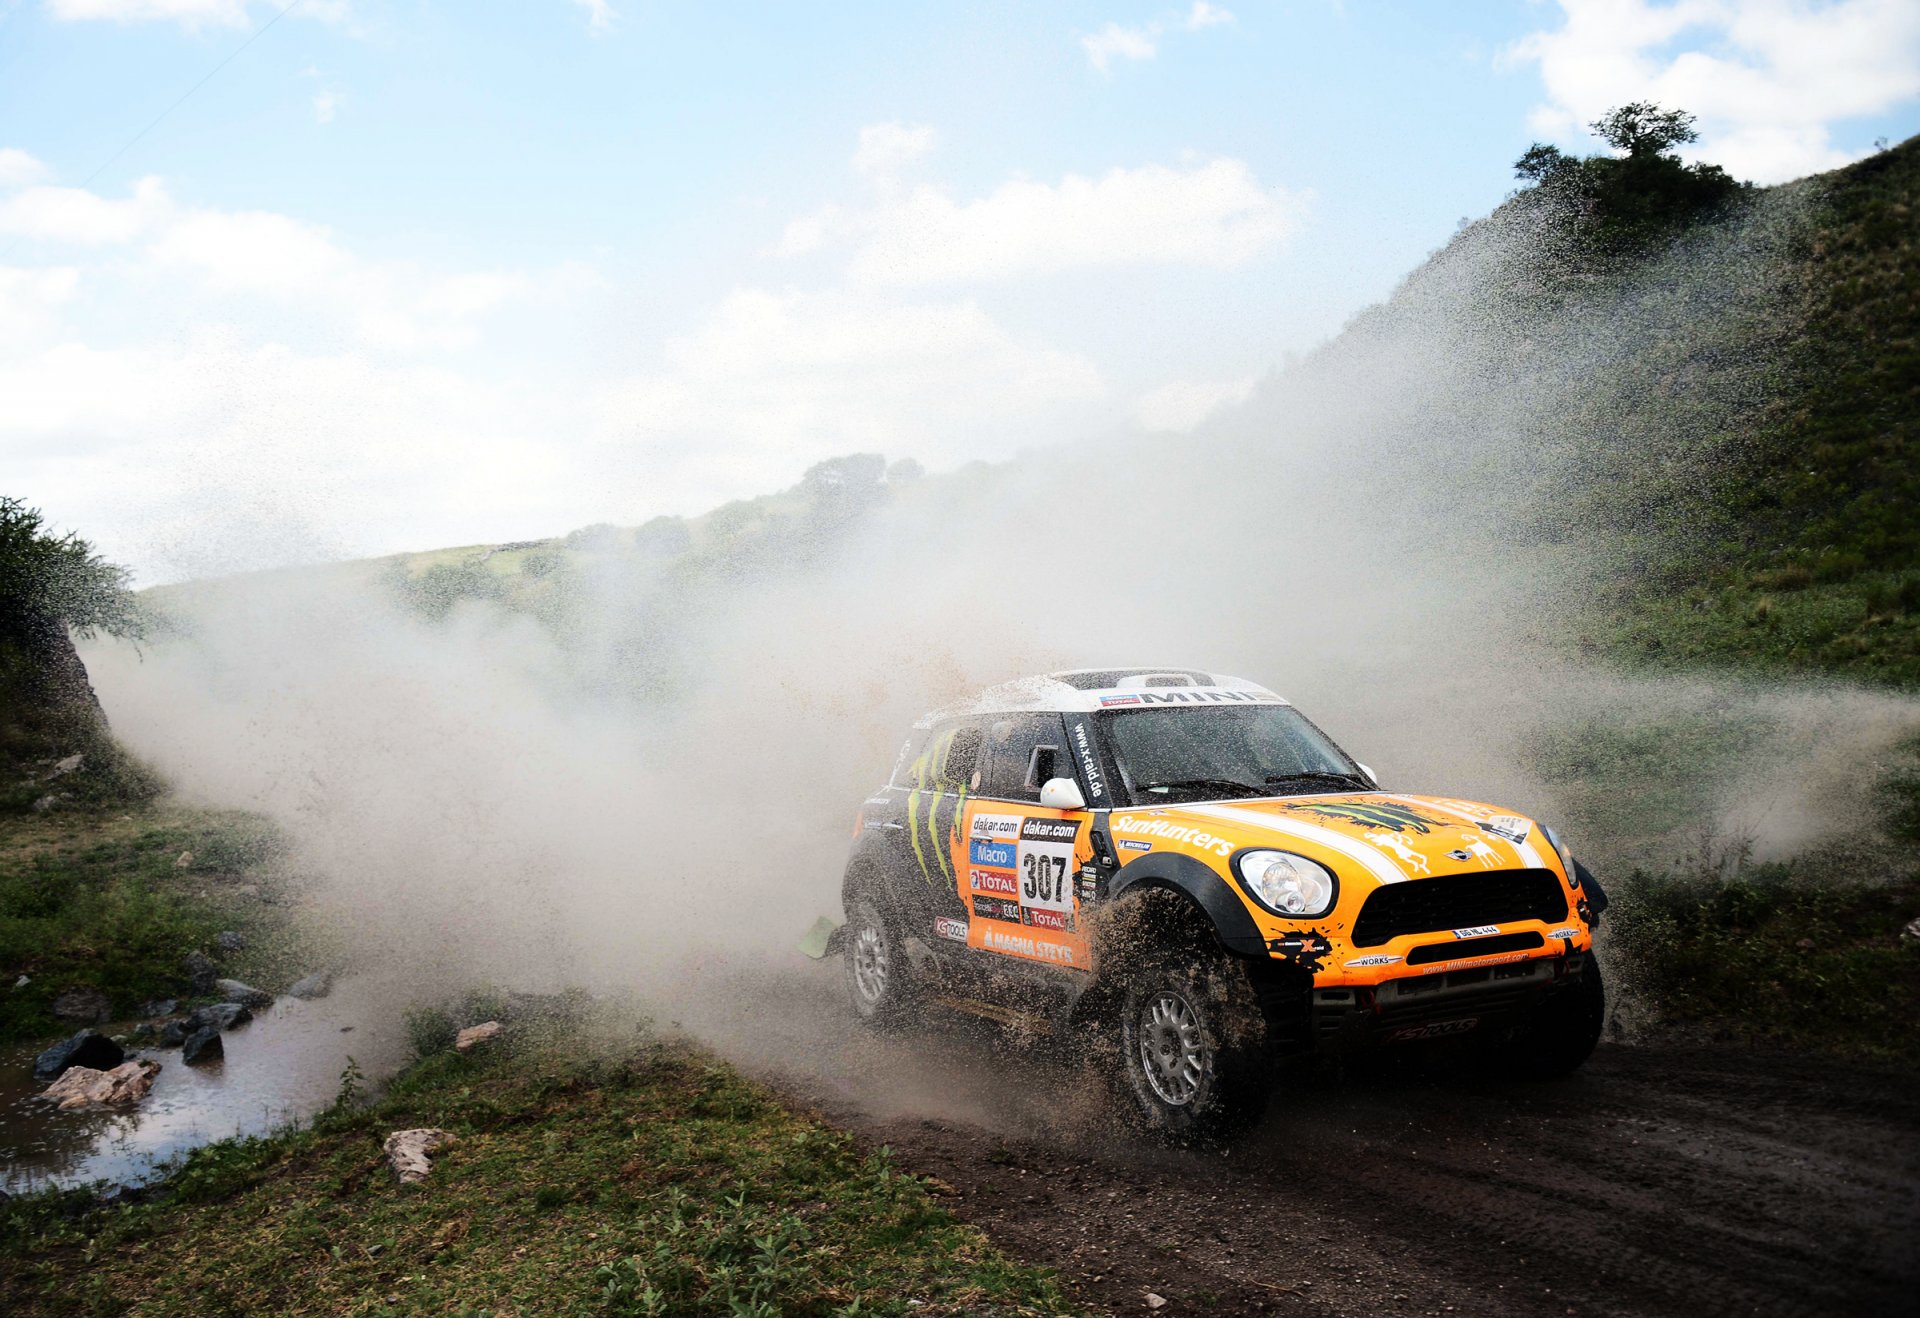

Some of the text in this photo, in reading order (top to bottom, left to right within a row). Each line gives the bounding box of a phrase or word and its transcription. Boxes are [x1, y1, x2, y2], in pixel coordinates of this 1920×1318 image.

[1139, 691, 1257, 704] MINI
[1074, 722, 1102, 798] www.x-raid.de
[973, 817, 1018, 833] dakar.com
[1023, 820, 1076, 838] dakar.com
[1112, 816, 1235, 857] SunHunters
[977, 845, 1007, 863] Macro
[978, 873, 1017, 893] TOTAL
[1023, 853, 1067, 903] 307
[1031, 911, 1065, 928] TOTAL
[994, 933, 1036, 956] MAGNA
[1360, 957, 1389, 966] WORKS
[1422, 953, 1529, 976] www.MINImotorsport.com
